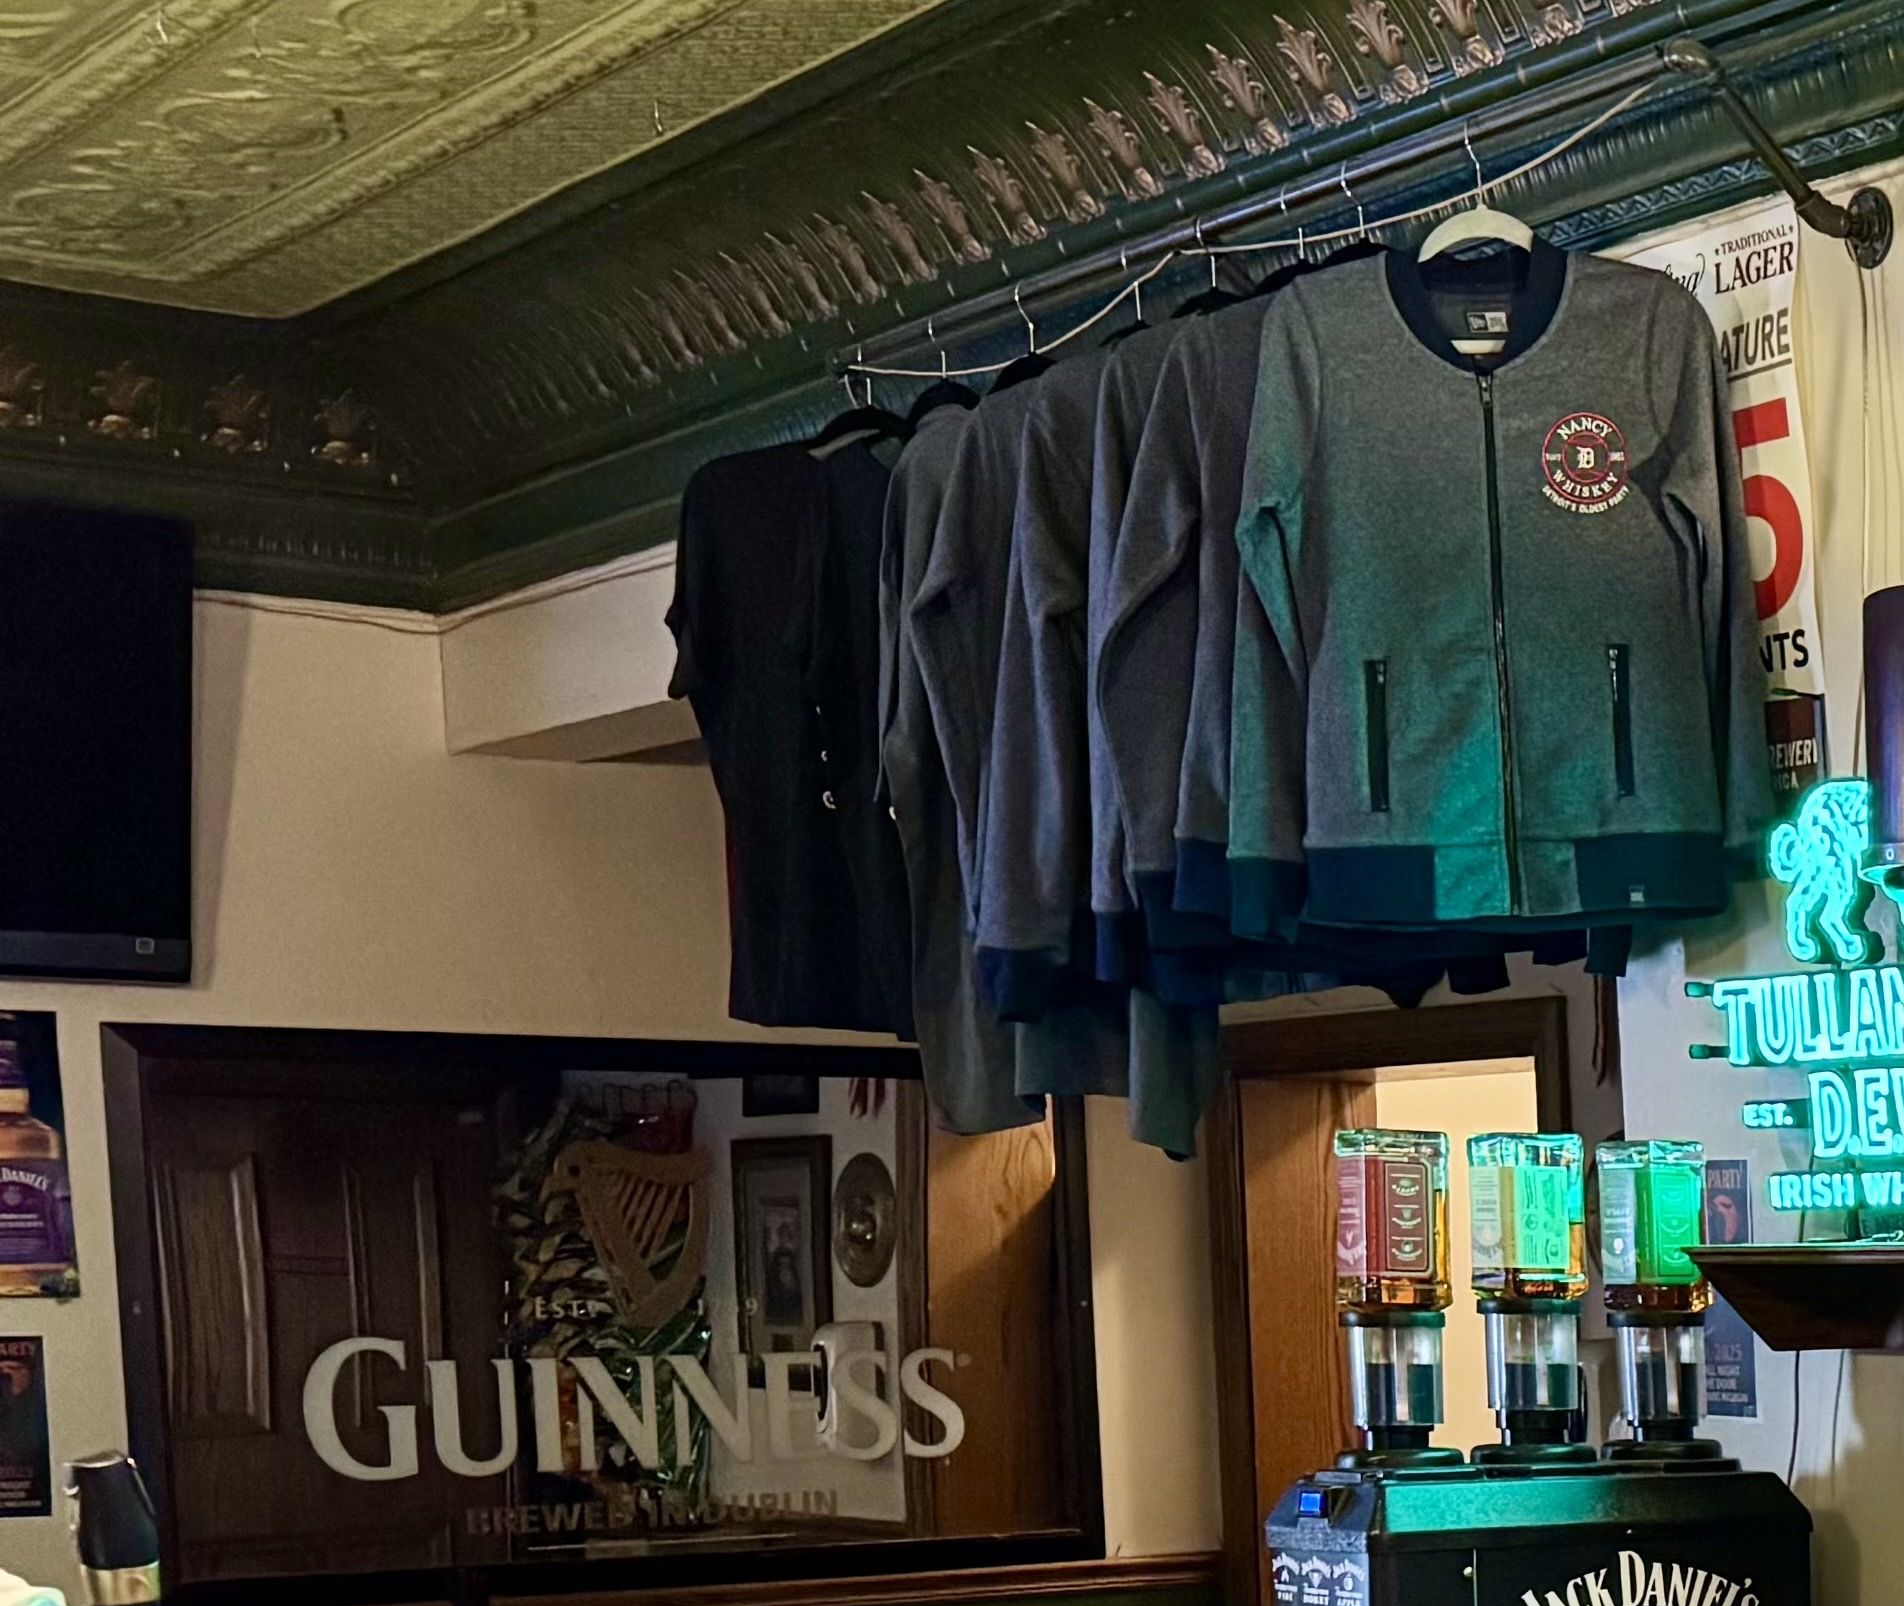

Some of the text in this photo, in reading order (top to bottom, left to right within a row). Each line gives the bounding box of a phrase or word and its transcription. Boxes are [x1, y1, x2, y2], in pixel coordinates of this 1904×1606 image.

[1721, 225, 1788, 254] TRADITIONAL
[1715, 241, 1793, 295] LAGER
[1557, 418, 1613, 440] NANCY
[1553, 470, 1618, 497] WHISKEY
[1743, 1103, 1793, 1126] EST.
[1770, 1173, 1854, 1208] IRISH
